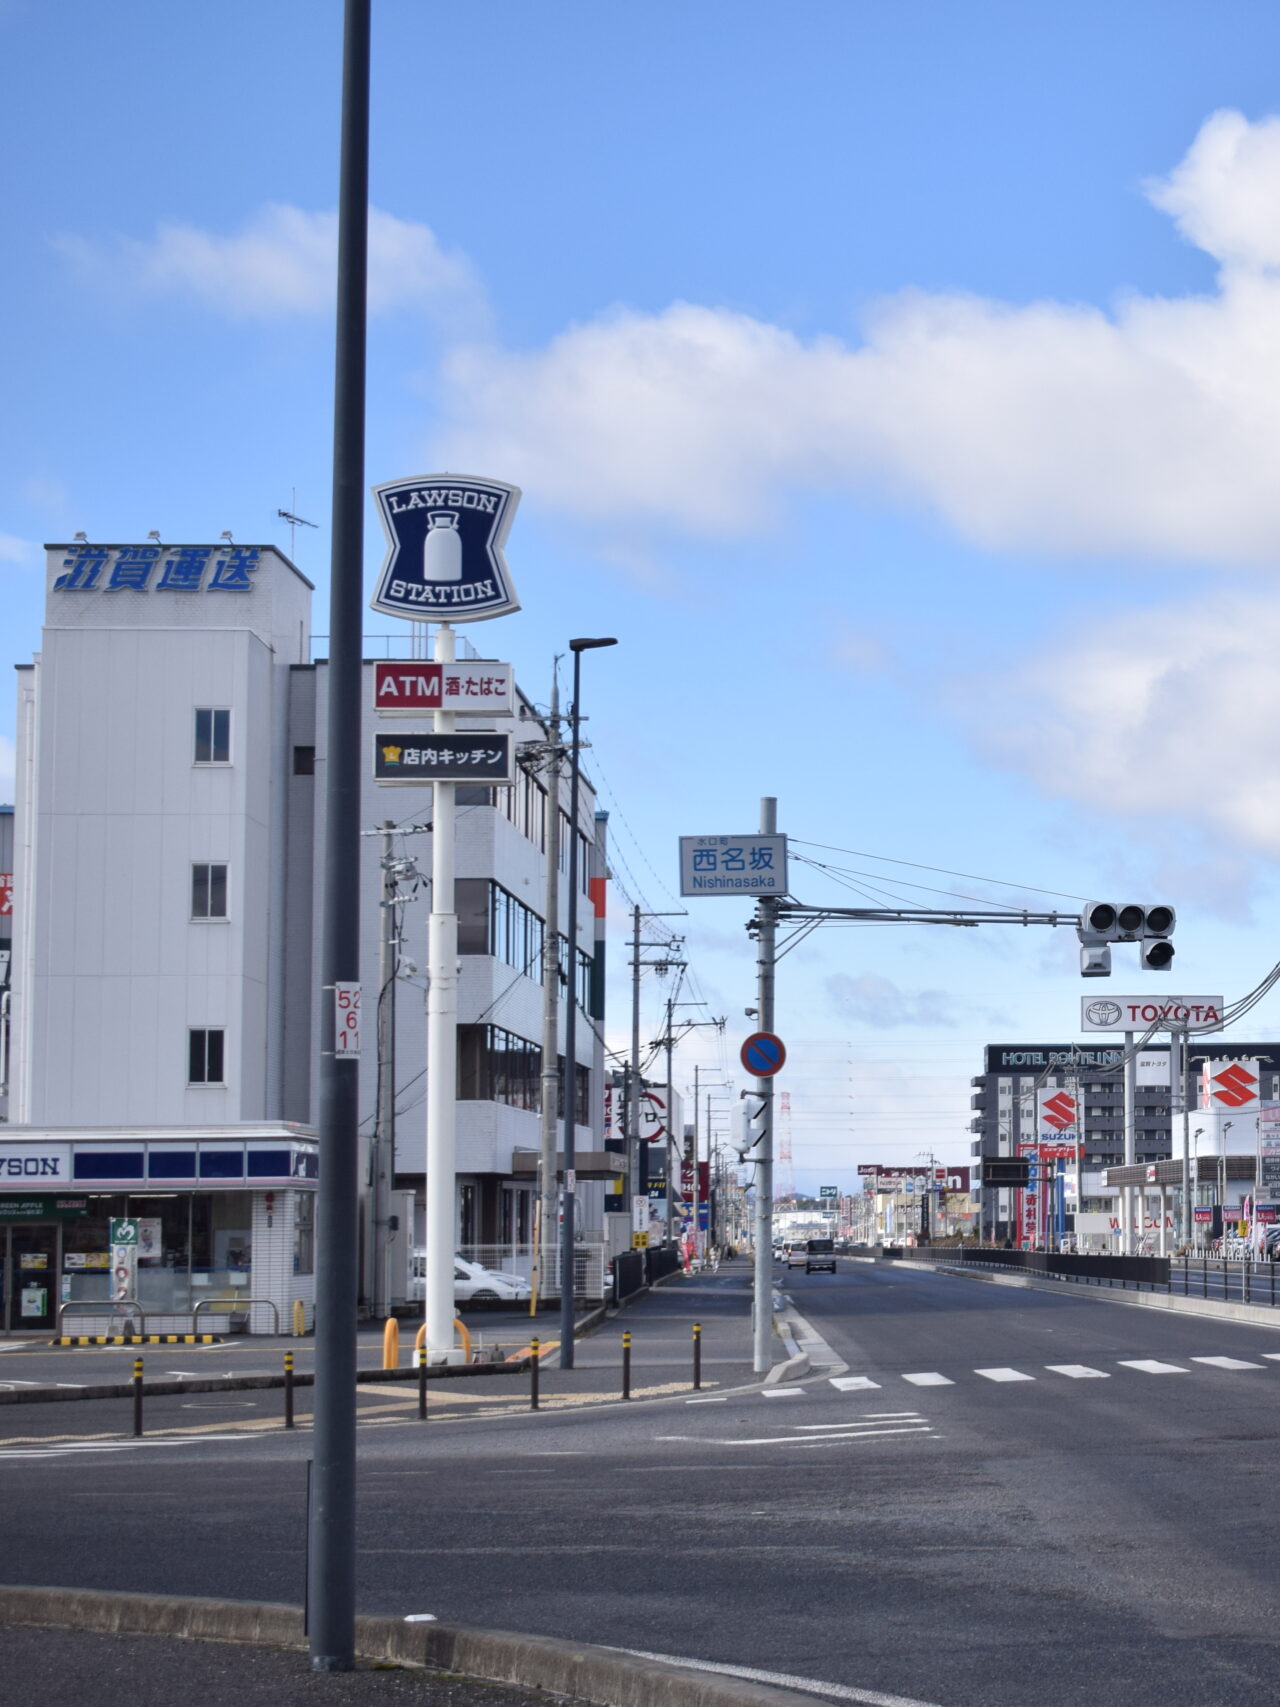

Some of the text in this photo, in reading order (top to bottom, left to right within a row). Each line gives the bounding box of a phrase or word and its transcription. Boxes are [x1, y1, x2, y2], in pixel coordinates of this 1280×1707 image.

[389, 489, 498, 515] LAWSON
[54, 547, 262, 592] 滋賀運送
[389, 579, 496, 604] STATION
[379, 676, 439, 697] ATM
[403, 748, 503, 766] 店内キッチン
[692, 846, 775, 872] 西名坂
[693, 875, 775, 889] Nishinasaka
[345, 1011, 358, 1030] 6
[1127, 1005, 1219, 1022] TOYOTA
[1002, 1052, 1048, 1066] HOTEL
[1049, 1051, 1096, 1066] ROUTE
[821, 1187, 837, 1196] ニトリ
